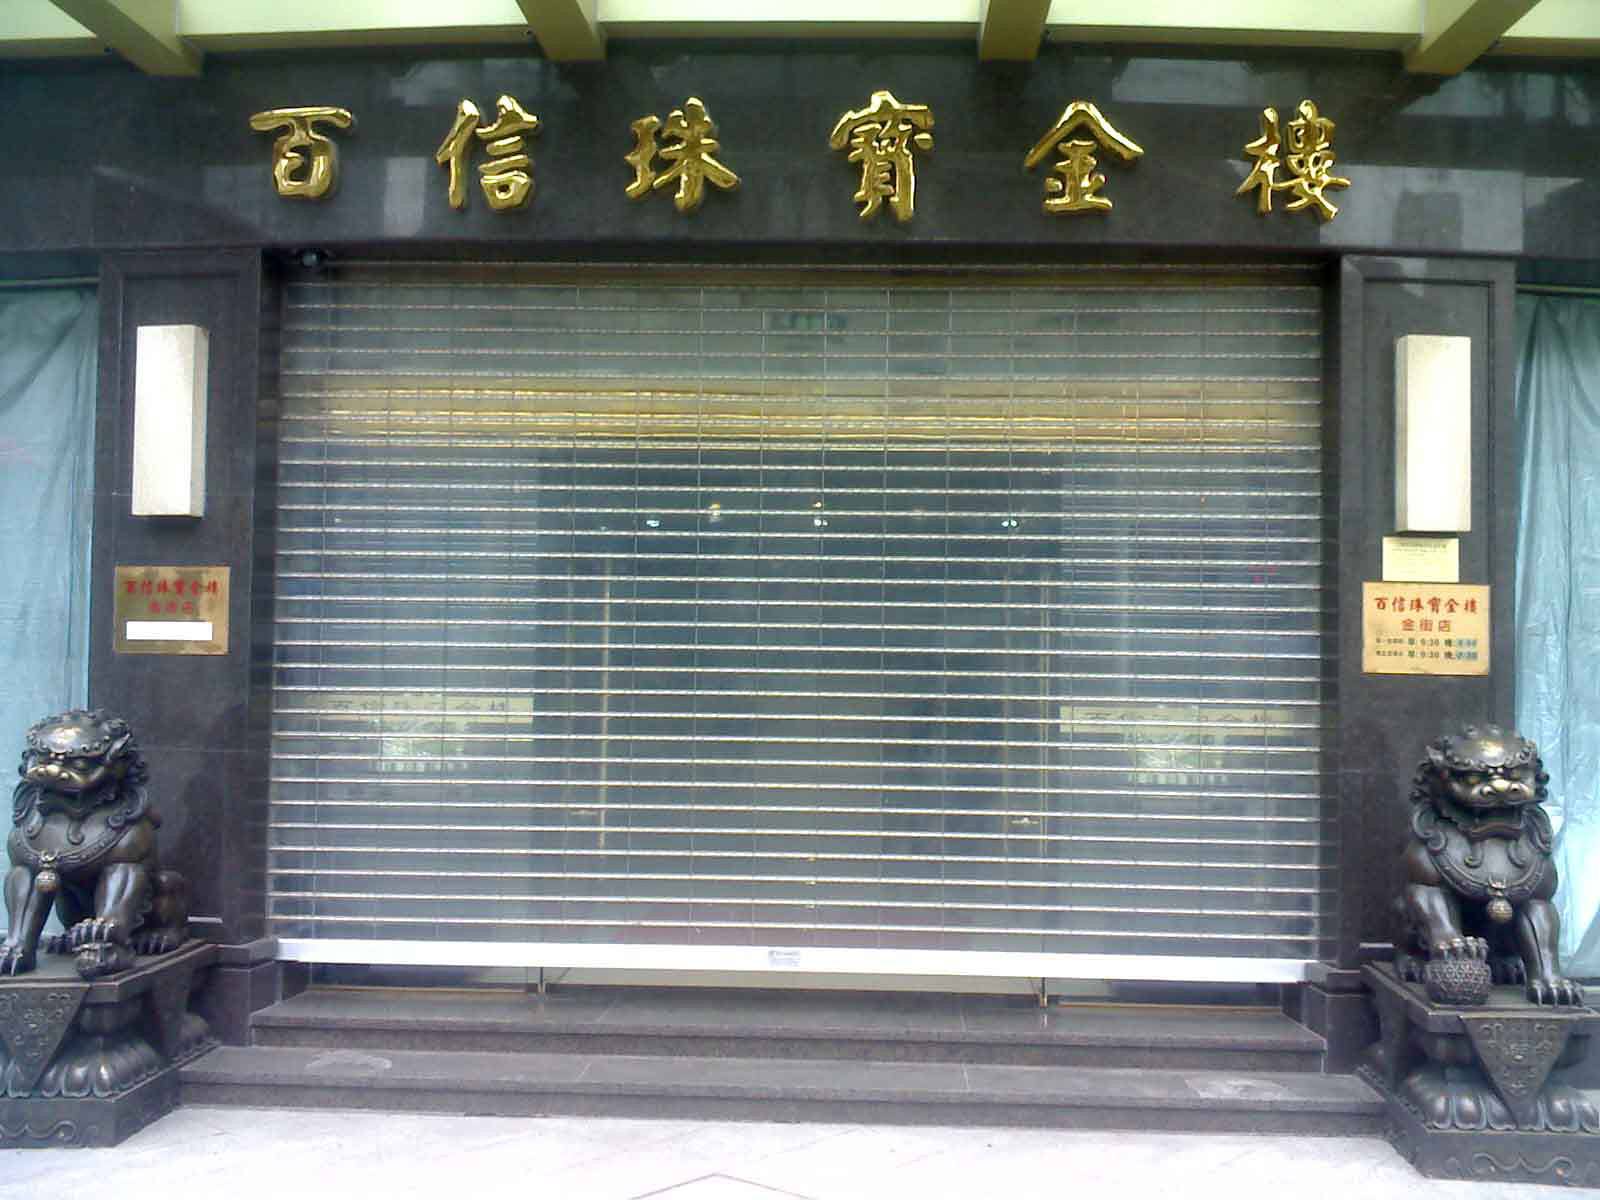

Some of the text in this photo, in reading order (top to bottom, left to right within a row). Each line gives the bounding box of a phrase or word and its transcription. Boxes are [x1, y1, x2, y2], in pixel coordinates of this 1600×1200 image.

[250, 90, 1352, 217] 百信珠寶金樓
[1374, 596, 1478, 614] 百信珠寶金樓
